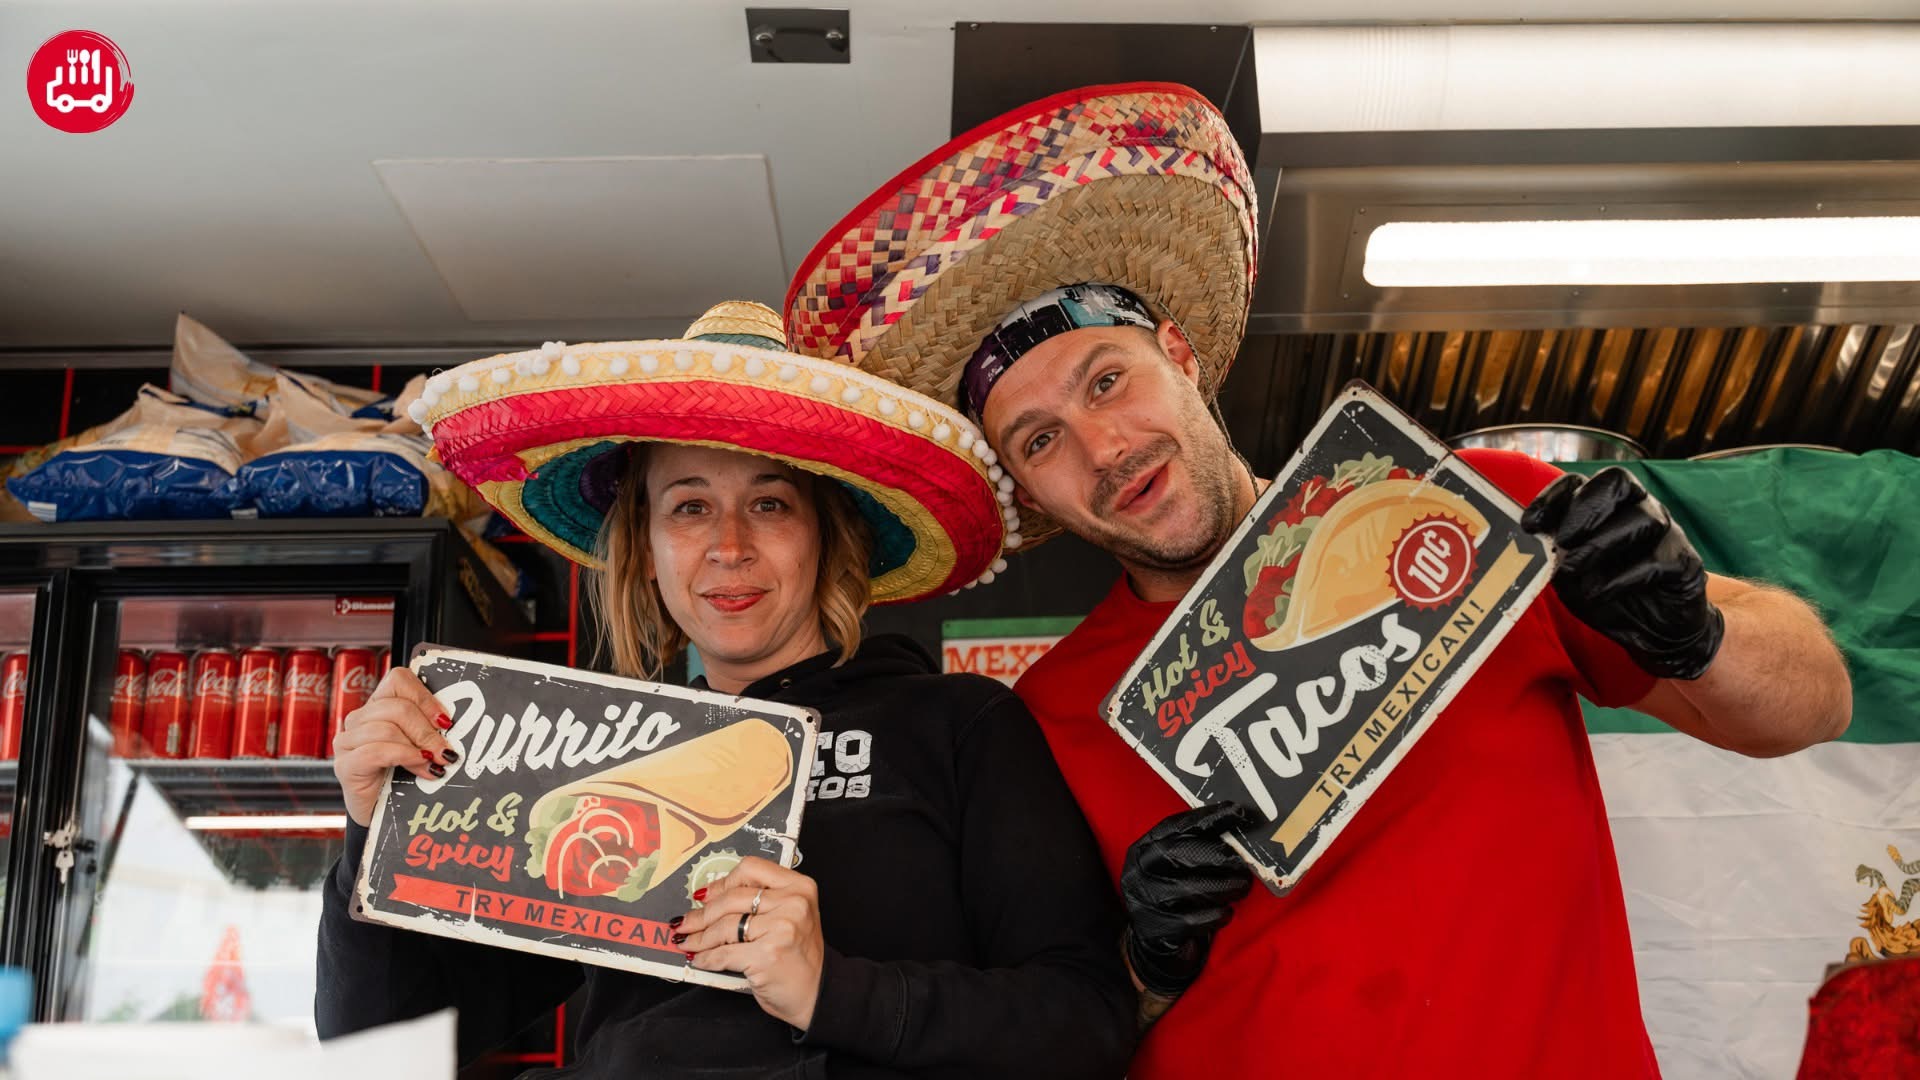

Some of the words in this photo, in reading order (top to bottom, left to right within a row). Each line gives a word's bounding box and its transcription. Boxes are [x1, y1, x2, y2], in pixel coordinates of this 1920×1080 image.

[946, 644, 1051, 676] MEX
[1142, 633, 1198, 716] Hot
[1200, 599, 1230, 647] &
[1157, 641, 1256, 738] Spicy
[1315, 744, 1363, 799] TRY
[1364, 600, 1485, 744] MEXICAN!
[415, 680, 681, 794] Burrito
[1175, 613, 1421, 821] Tacos
[404, 834, 514, 882] Spicy
[408, 797, 482, 836] Hot
[487, 792, 523, 837] &
[456, 889, 515, 917] TRY
